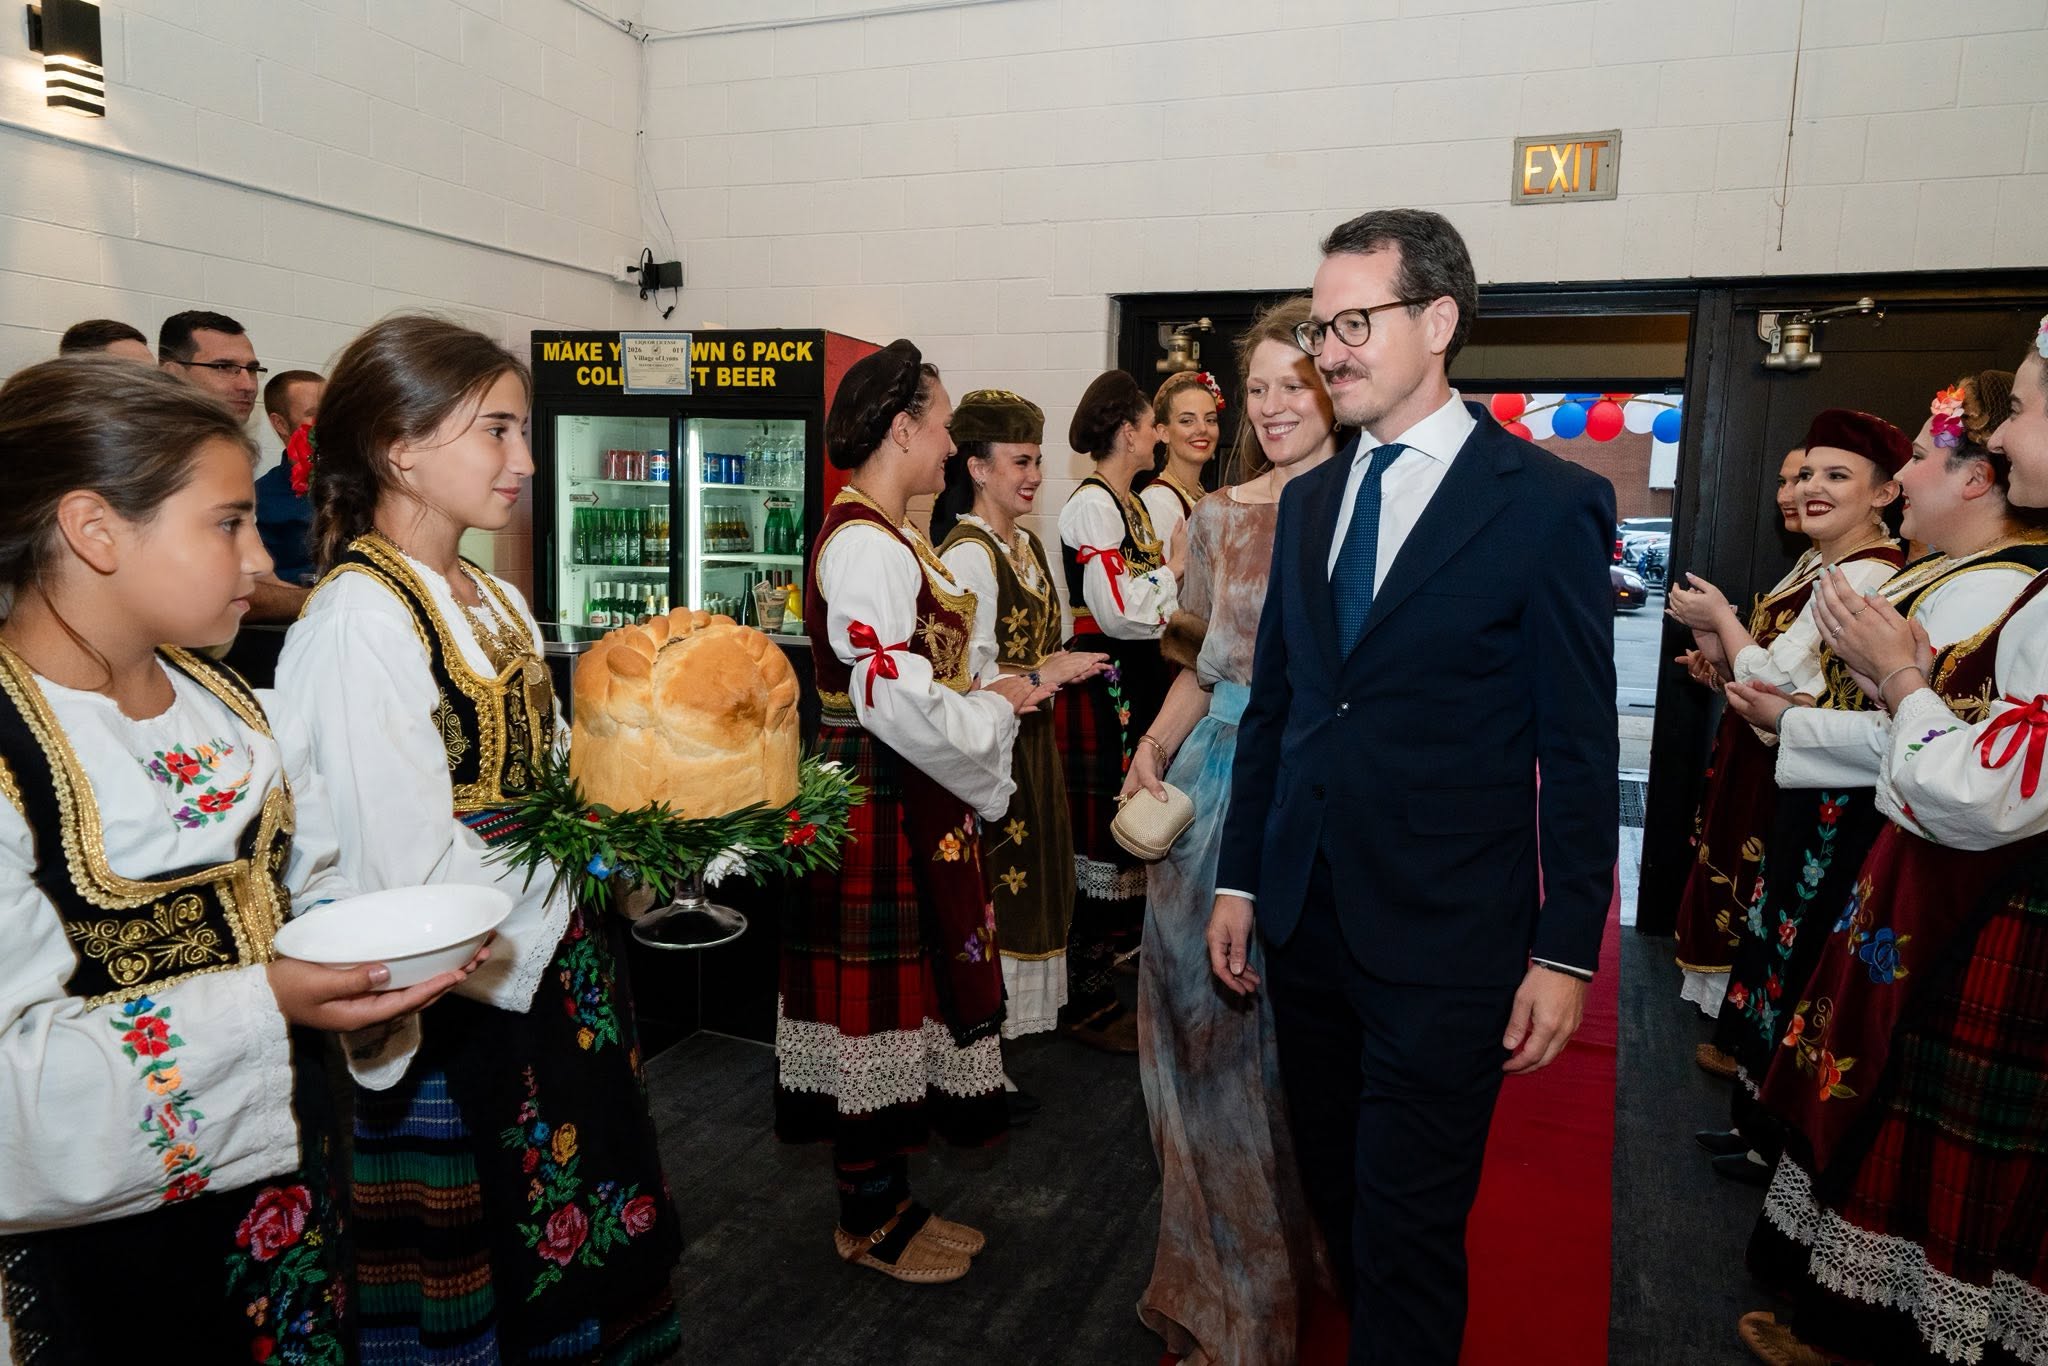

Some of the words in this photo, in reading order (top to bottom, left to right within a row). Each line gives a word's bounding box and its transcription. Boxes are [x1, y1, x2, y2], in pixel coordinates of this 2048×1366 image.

[1523, 140, 1609, 195] EXIT
[543, 342, 603, 361] MAKE
[690, 342, 726, 362] WN
[732, 342, 746, 361] 6
[752, 342, 814, 361] PACK
[717, 367, 776, 387] BEER
